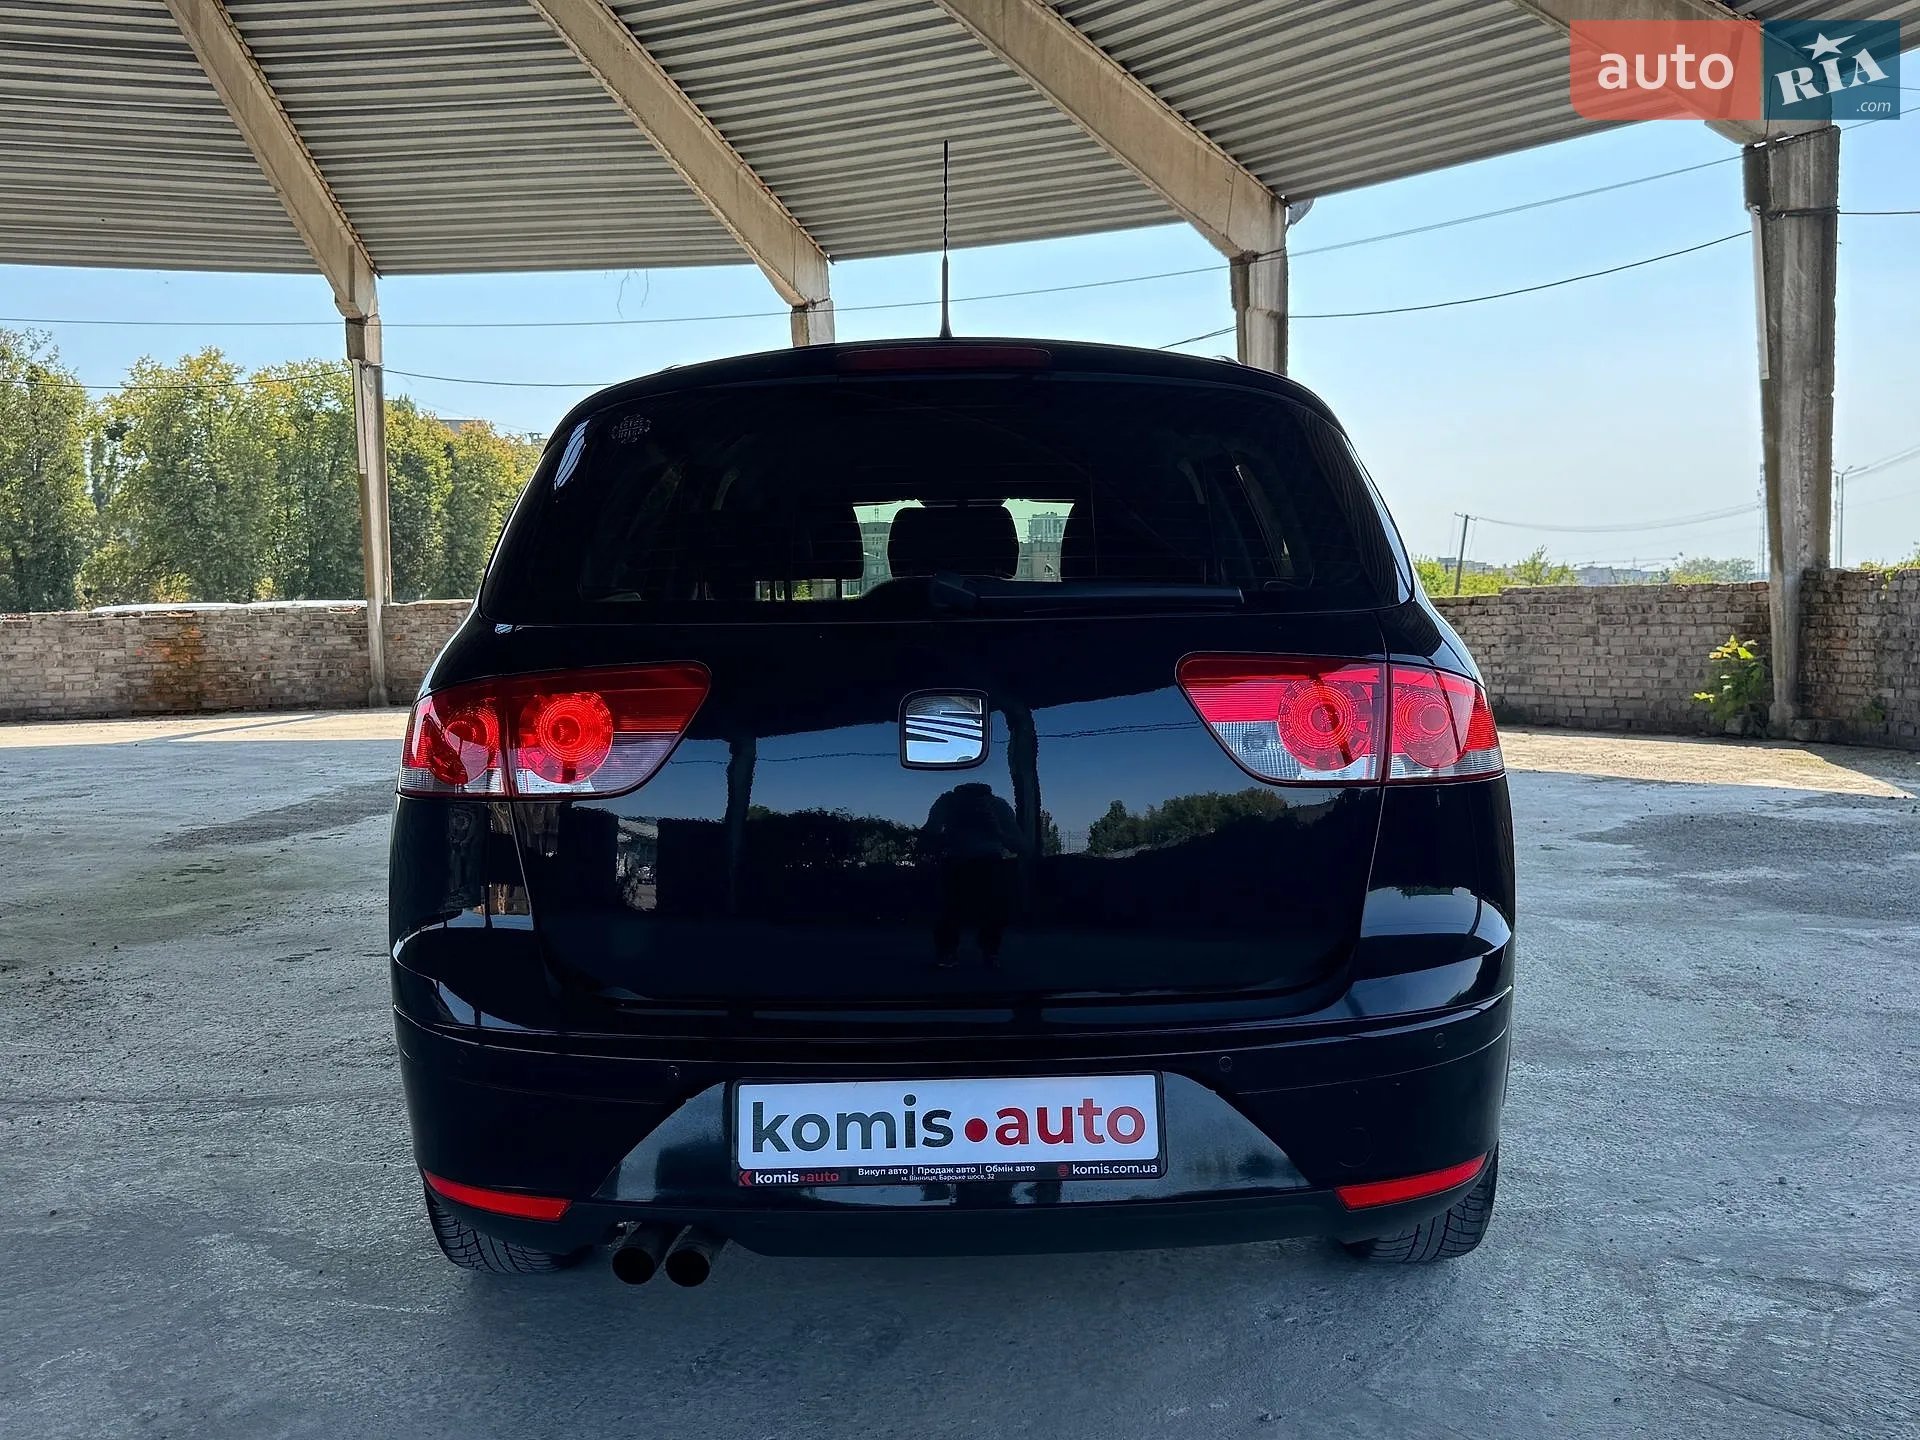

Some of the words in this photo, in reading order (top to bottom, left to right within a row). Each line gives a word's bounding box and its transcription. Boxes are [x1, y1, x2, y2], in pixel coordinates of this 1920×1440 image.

[858, 1167, 886, 1177] Викуп
[888, 1167, 908, 1175] авто
[917, 1166, 953, 1176] Продаж
[956, 1166, 976, 1174] авто
[985, 1164, 1014, 1173] Обмін
[1015, 1165, 1036, 1173] авто
[1072, 1163, 1158, 1175] komis.com.ua
